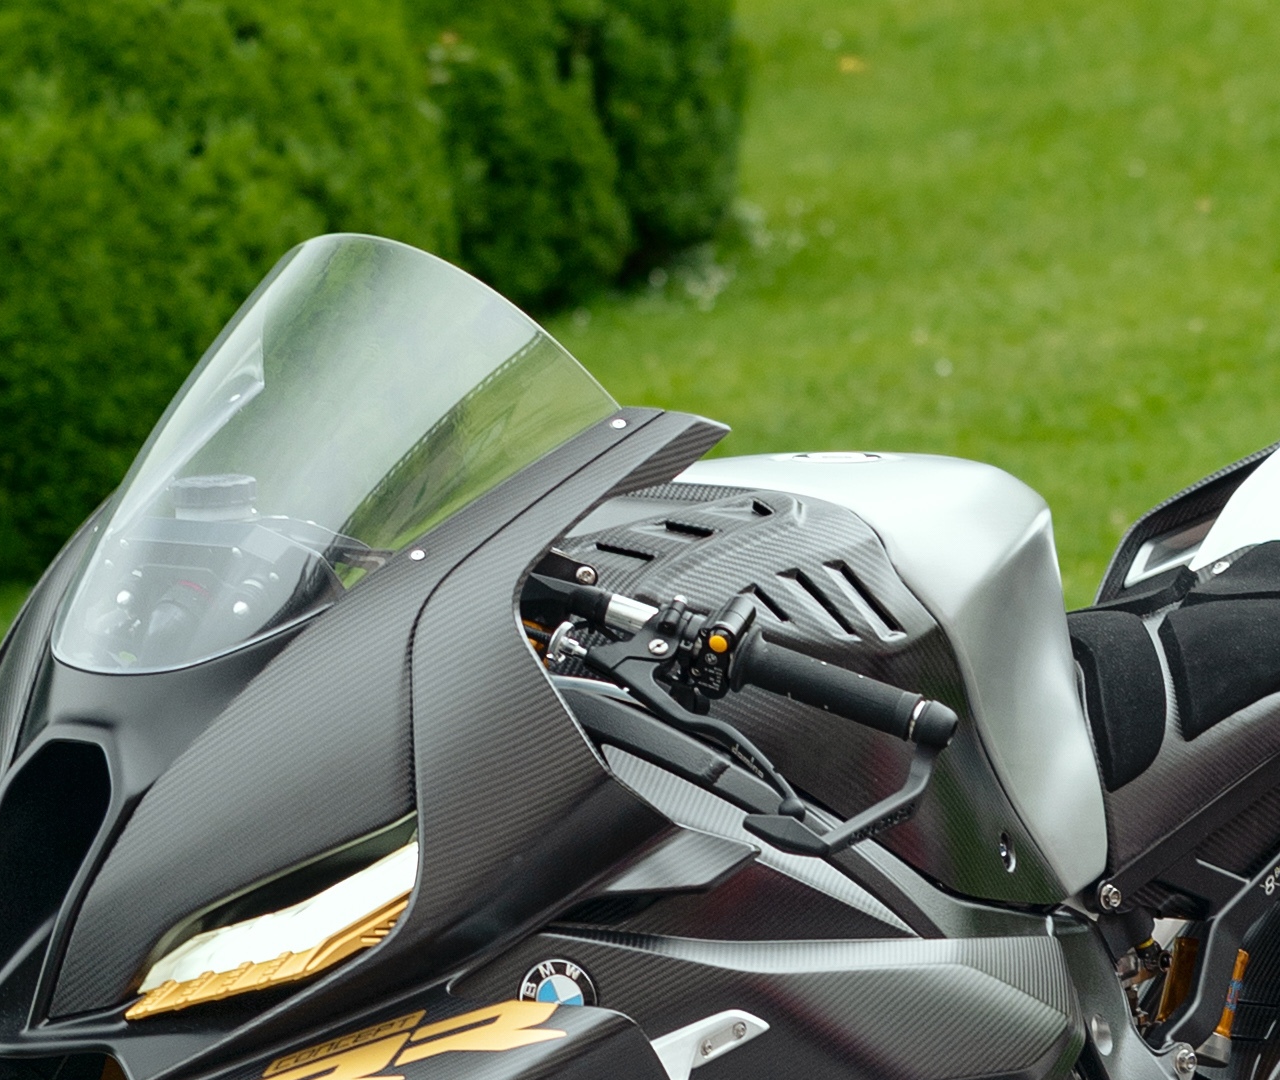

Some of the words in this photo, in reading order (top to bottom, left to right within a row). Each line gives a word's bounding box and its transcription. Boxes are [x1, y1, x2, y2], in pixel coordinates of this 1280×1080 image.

[731, 743, 764, 779] domino
[524, 961, 582, 999] BMW
[274, 1014, 417, 1071] CONCEPT
